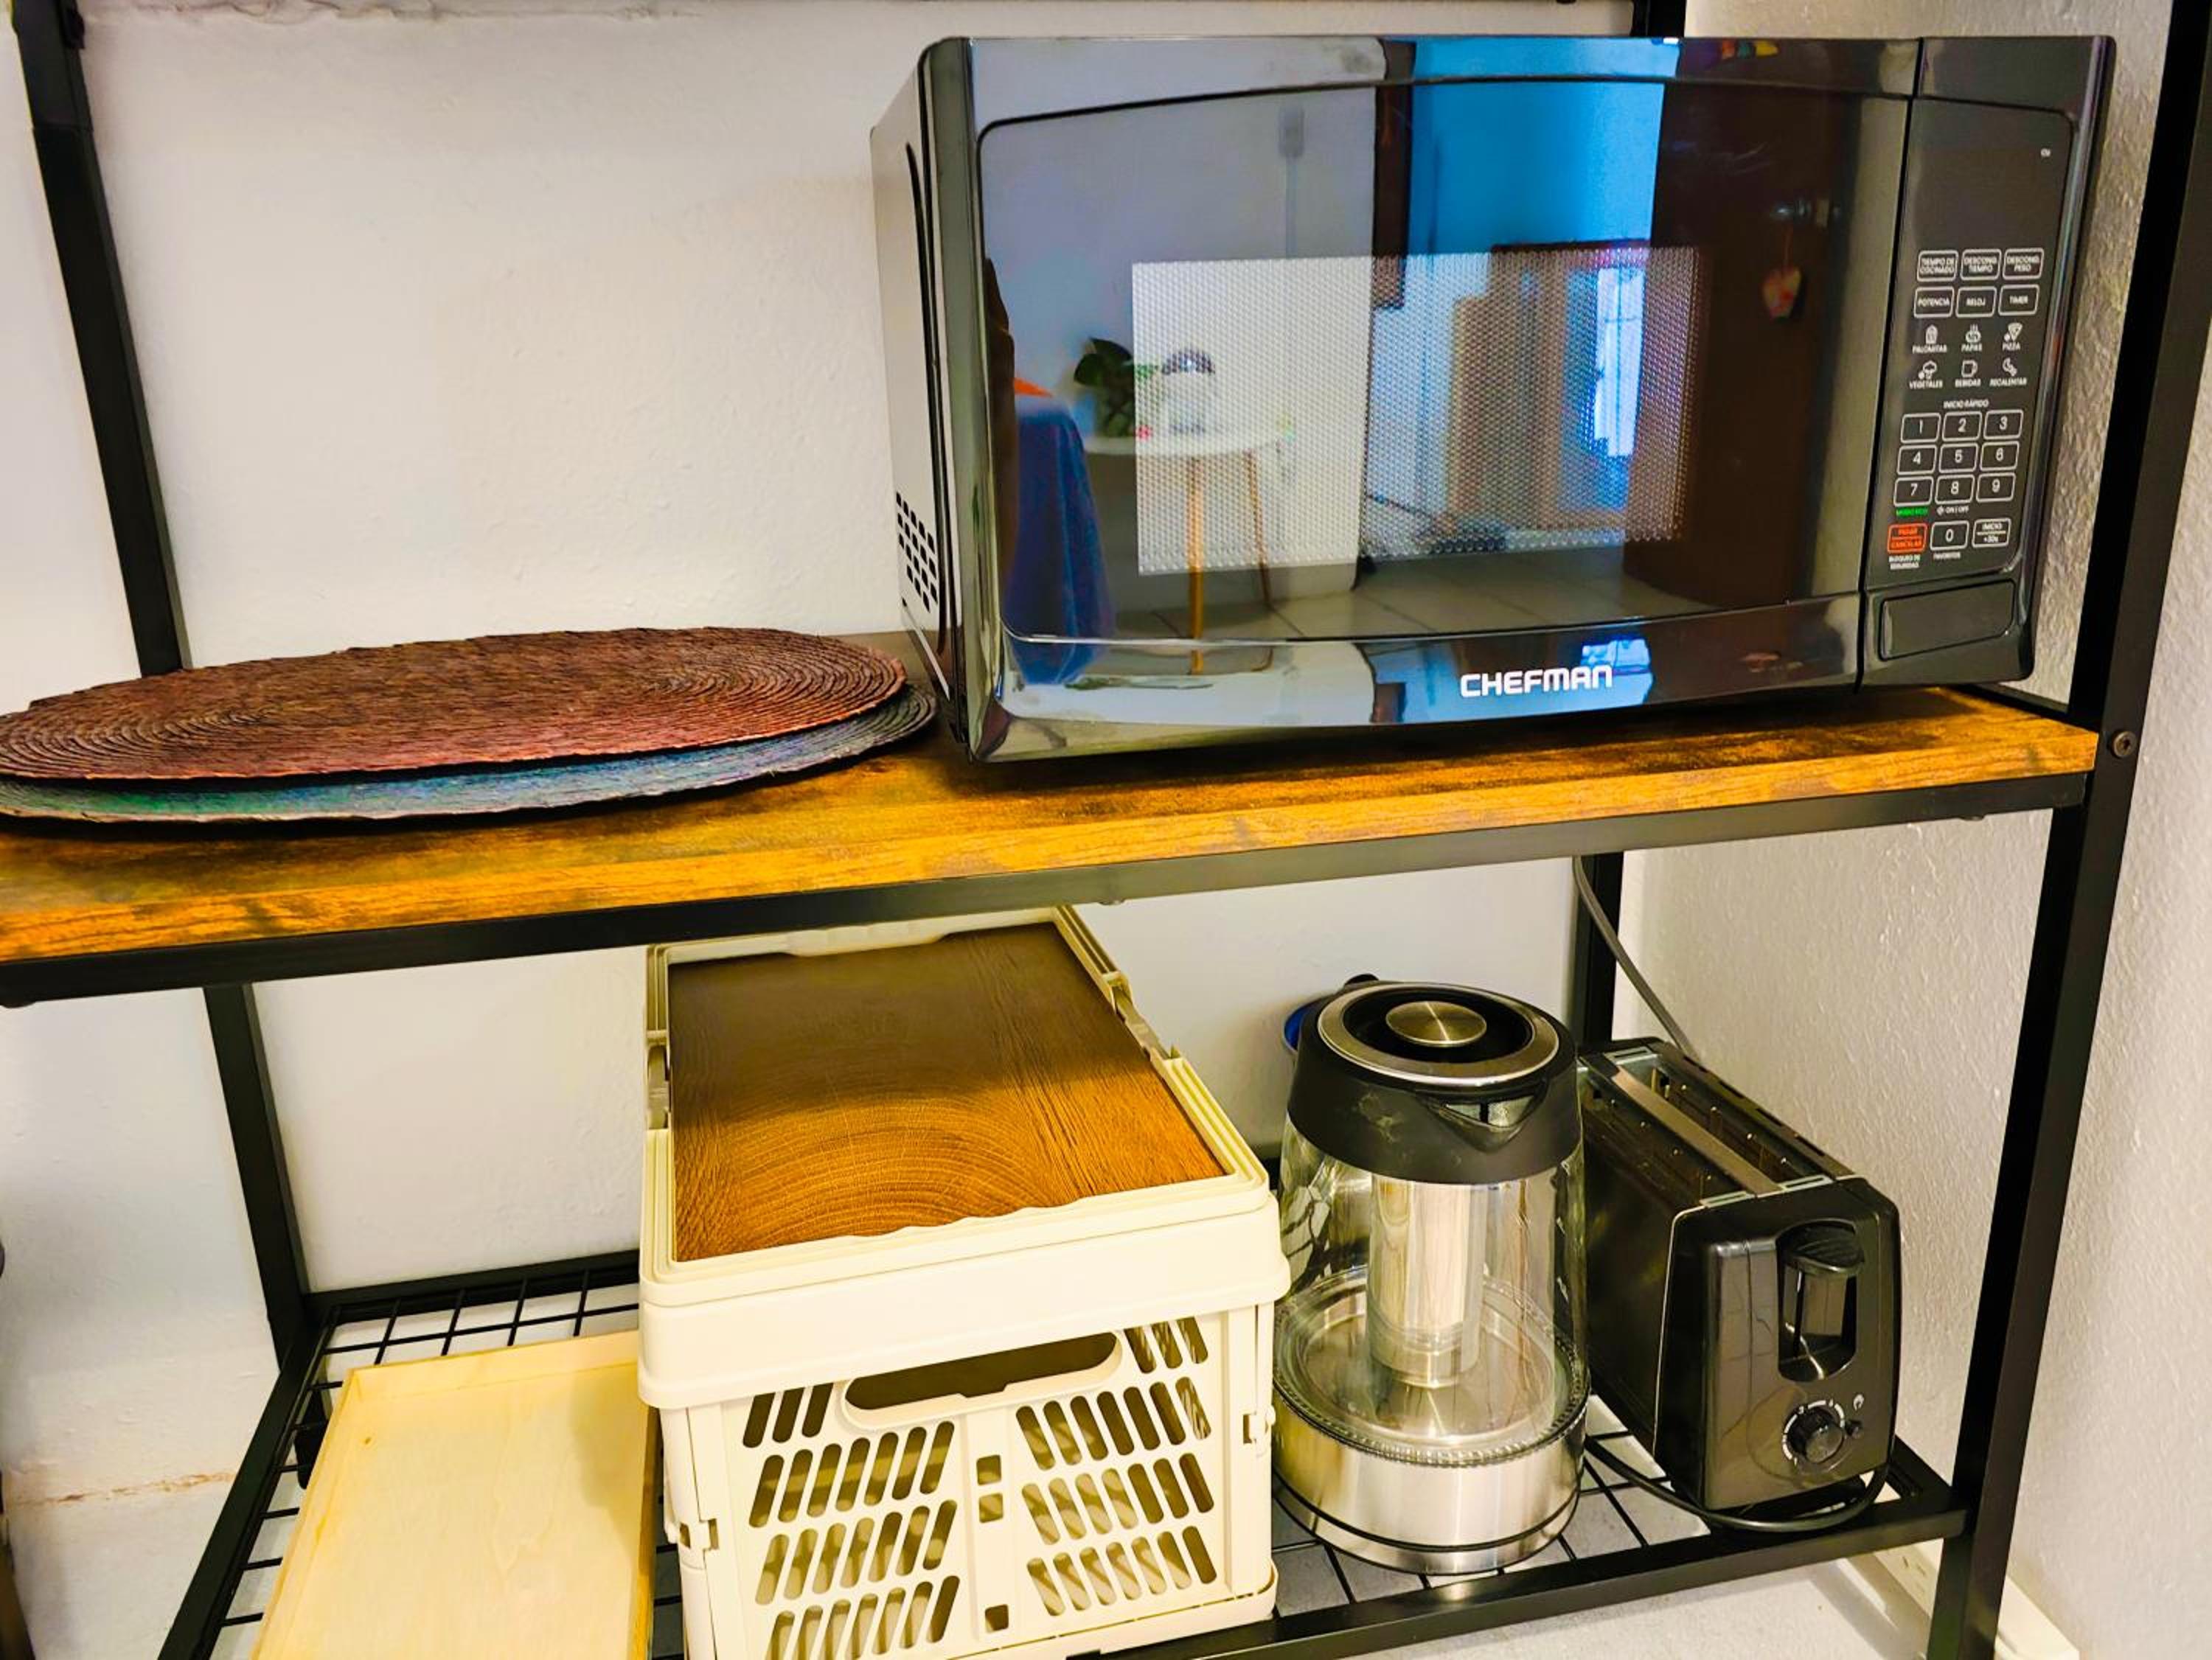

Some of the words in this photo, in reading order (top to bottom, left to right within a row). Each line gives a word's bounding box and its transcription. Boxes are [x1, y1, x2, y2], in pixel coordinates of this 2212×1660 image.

[1917, 298, 1950, 307] POTENCIA
[1966, 298, 1986, 307] RELOJ
[2003, 342, 2020, 351] PIZZA
[1909, 380, 1944, 389] VEGETALES
[1989, 377, 2028, 386] RECALENTAR
[1919, 420, 1923, 434] 1
[1958, 419, 1966, 433] 2
[1999, 416, 2008, 430] 3
[1913, 451, 1921, 464] 4
[1955, 450, 1963, 463] 5
[1995, 447, 2004, 461] 6
[1910, 482, 1919, 496] 7
[1951, 481, 1959, 495] 8
[1992, 479, 2000, 492] 9
[1945, 529, 1954, 543] 0
[1461, 665, 1613, 697] CHEFMAN
